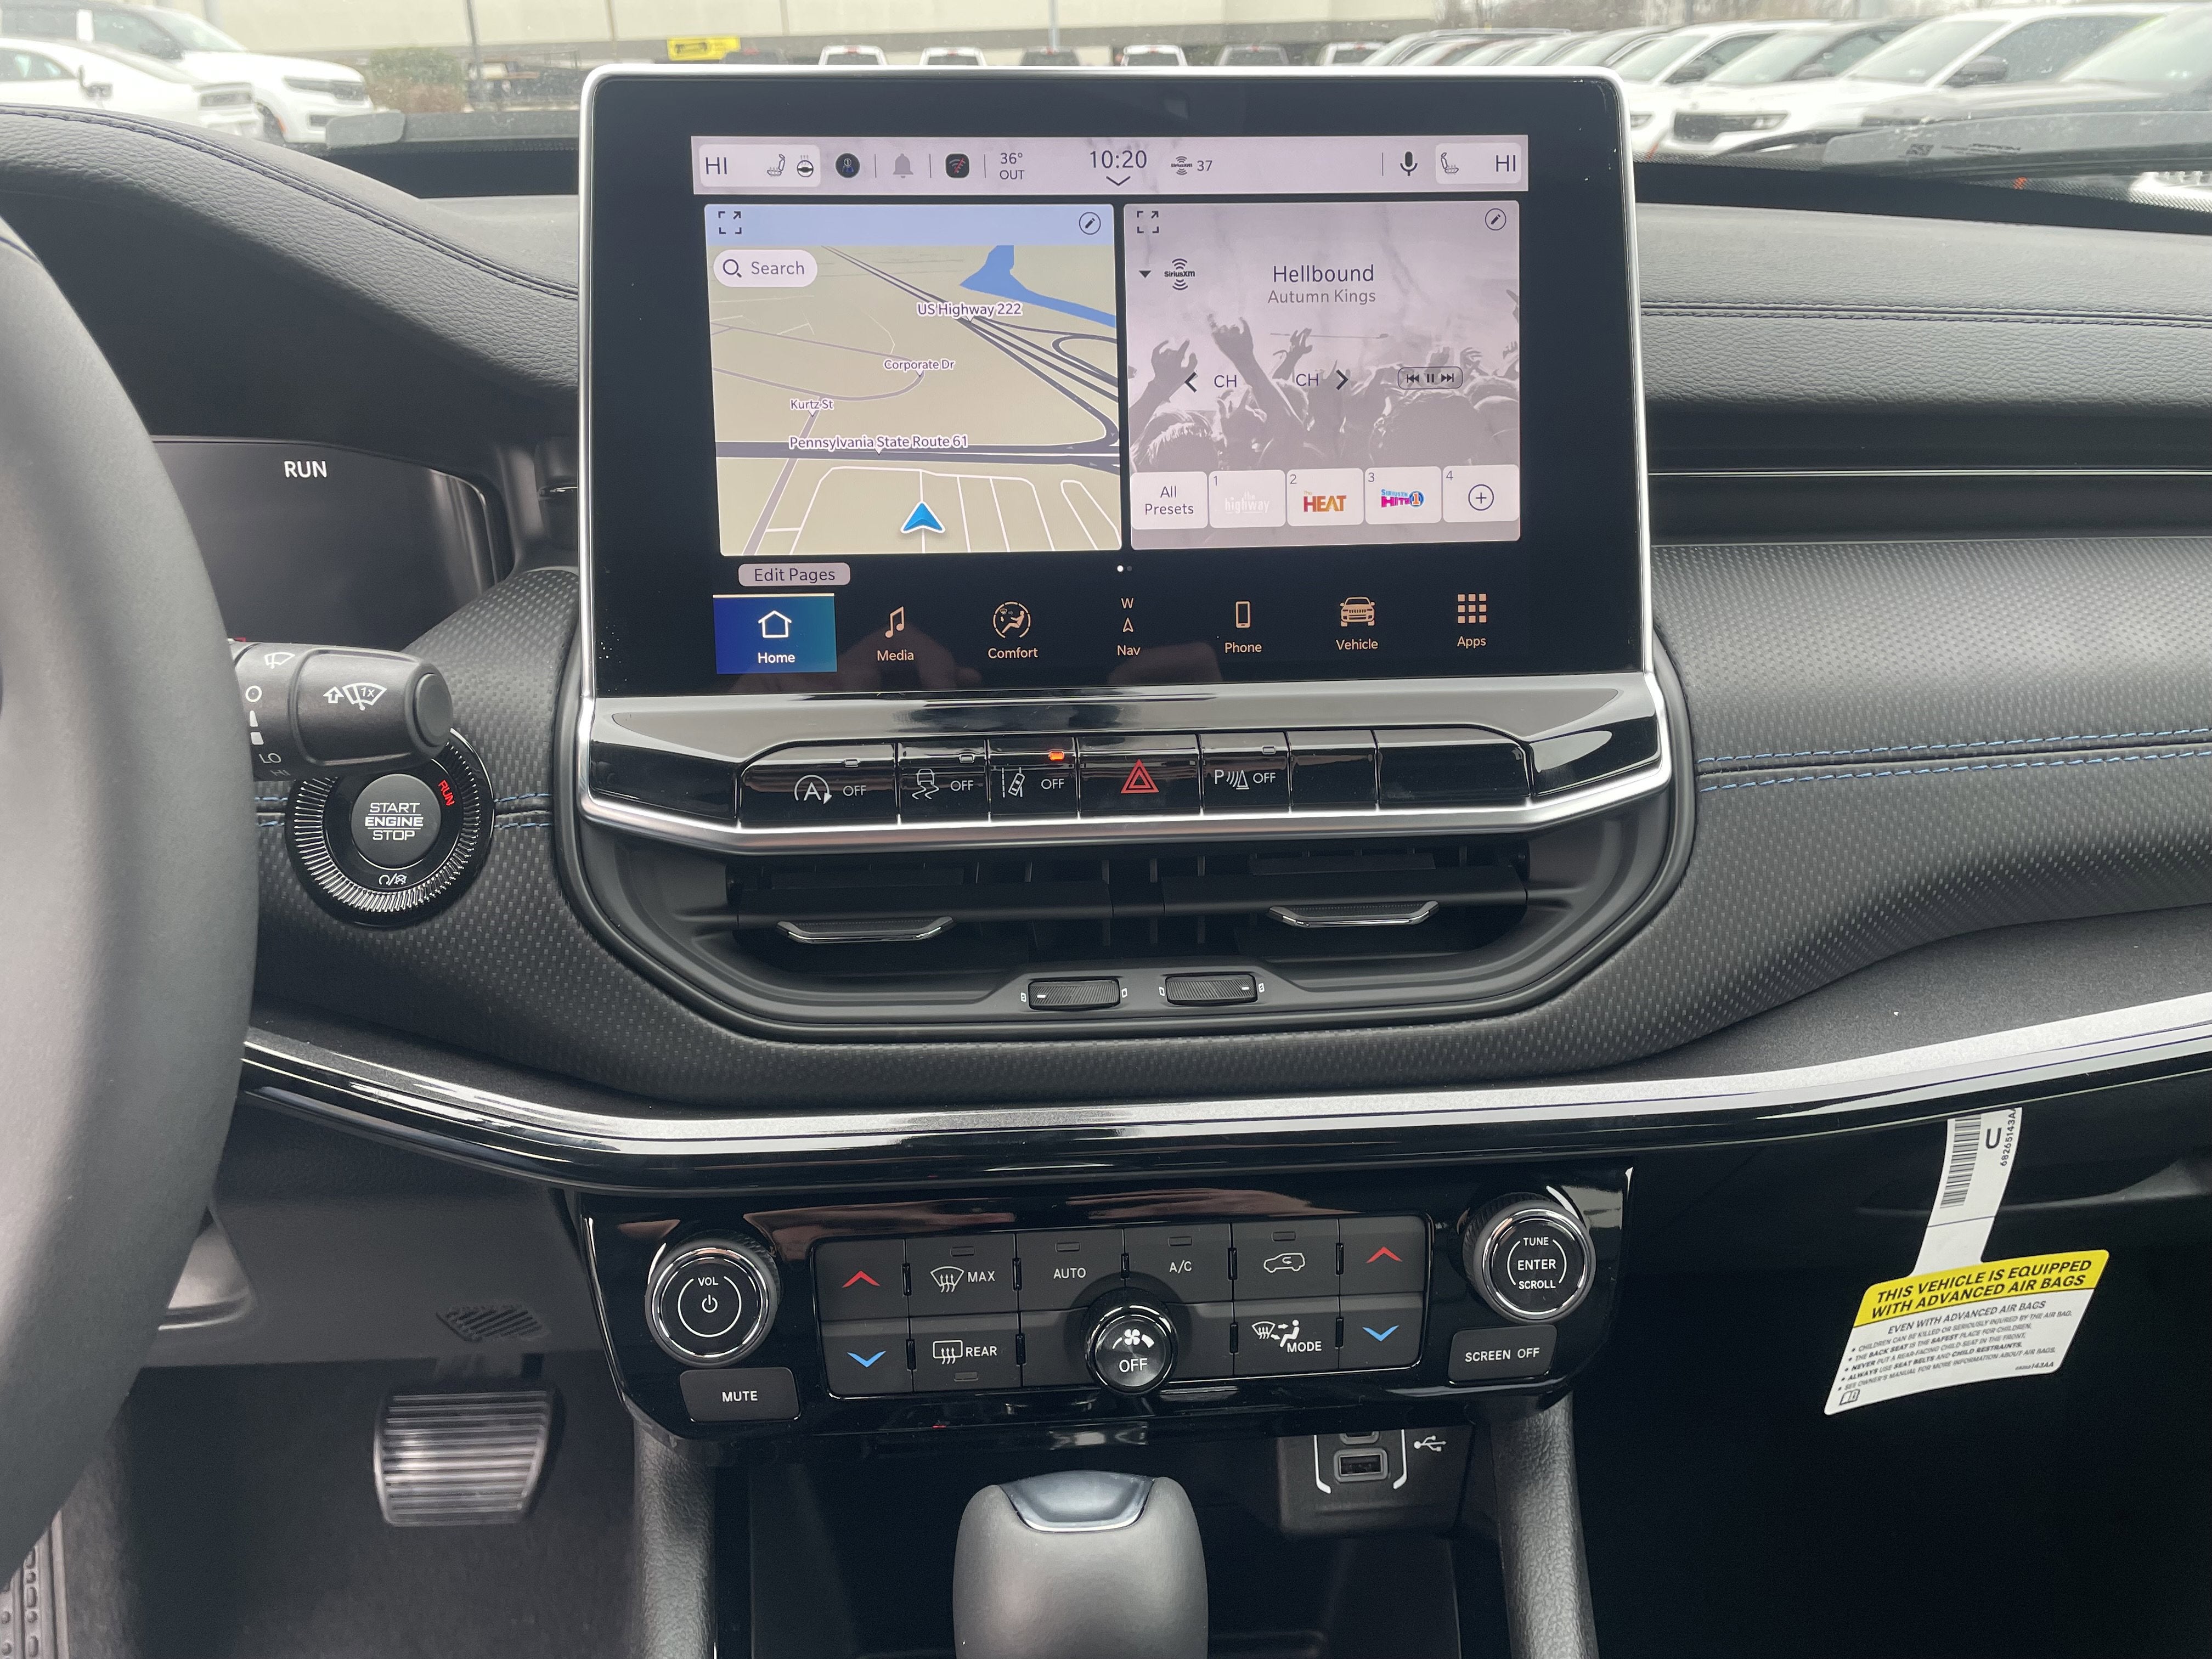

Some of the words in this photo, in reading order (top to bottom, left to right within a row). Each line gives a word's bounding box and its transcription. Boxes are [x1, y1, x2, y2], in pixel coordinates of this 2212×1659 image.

[1000, 153, 1023, 165] 36°
[1090, 150, 1147, 169] 10:20
[1496, 155, 1516, 172] HI
[705, 157, 727, 175] HI
[1197, 160, 1212, 171] 37
[1000, 170, 1025, 180] OUT
[751, 261, 805, 275] Search
[1273, 264, 1374, 283] Hellbound
[1268, 290, 1329, 304] Autumn
[1334, 289, 1376, 306] Kings
[918, 303, 935, 315] US
[938, 303, 995, 318] Highway
[997, 303, 1022, 315] 222
[884, 359, 939, 372] Corporate
[941, 359, 955, 370] Dr
[1214, 374, 1238, 387] CH
[1295, 373, 1319, 386] CH
[791, 399, 820, 410] Kurtz
[821, 399, 833, 410] St
[788, 436, 874, 451] Pennsylvania
[877, 436, 910, 448] State
[912, 436, 949, 448] Route
[952, 435, 968, 448] 61
[284, 461, 328, 478] RUN
[1213, 476, 1218, 486] 1
[1290, 474, 1297, 484] 2
[1368, 472, 1375, 483] 3
[1446, 470, 1453, 482] 4
[1160, 486, 1177, 498] All
[1145, 503, 1194, 516] Presets
[1224, 497, 1269, 514] highway
[1303, 495, 1347, 513] HEAT
[754, 568, 786, 582] Edit
[789, 568, 836, 584] Pages
[1121, 598, 1134, 608] W
[1224, 642, 1262, 653] Phone
[1336, 639, 1379, 651] Vehicle
[1457, 636, 1487, 650] Apps
[877, 650, 915, 662] Media
[988, 647, 1039, 659] Comfort
[1117, 645, 1141, 656] Nav
[758, 652, 795, 664] Home
[259, 753, 281, 764] LO
[1041, 778, 1065, 789] OFF
[1252, 772, 1276, 783] OFF
[843, 785, 867, 797] OFF
[950, 780, 974, 792] OFF
[438, 780, 455, 807] RUN
[370, 803, 420, 814] START
[365, 816, 424, 827] ENGINE
[373, 830, 415, 840] STOP
[1986, 1127, 2002, 1149] U
[1523, 1237, 1550, 1246] TUNE
[1169, 1260, 1192, 1273] A/C
[1517, 1259, 1556, 1271] ENTER
[967, 1271, 995, 1283] MAX
[1053, 1267, 1087, 1279] AUTO
[698, 1277, 719, 1286] VOL
[1519, 1279, 1556, 1289] SCROLL
[1877, 1285, 1914, 1304] THIS
[1918, 1272, 1987, 1294] VEHICLE
[1988, 1269, 2005, 1282] IS
[2007, 1260, 2092, 1279] EQUIPPED
[1871, 1299, 1913, 1319] WITH
[1915, 1284, 2005, 1309] ADVANCED
[2007, 1279, 2037, 1293] AIR
[2040, 1274, 2086, 1289] BAGS
[1888, 1322, 1915, 1334] EVEN
[1917, 1316, 1942, 1328] WITH
[1943, 1307, 1997, 1323] ADVANCED
[2000, 1304, 2017, 1313] AIR
[2018, 1301, 2046, 1310] BAGS
[1858, 1339, 1892, 1352] CHILDREN
[1892, 1335, 1907, 1344] CAN
[1918, 1328, 1940, 1338] KILLED
[1953, 1319, 1989, 1331] SERIOUSLY
[1990, 1316, 2018, 1325] INJURED
[1286, 1340, 1322, 1353] MODE
[1855, 1353, 1867, 1361] THE
[1869, 1348, 1889, 1358] BACK
[1890, 1344, 1908, 1353] SEAT
[1917, 1339, 1930, 1347] THE
[1931, 1334, 1959, 1344] SAFEST
[1959, 1329, 1981, 1339] PLACE
[1996, 1323, 2032, 1333] CHILDREN.
[966, 1346, 997, 1357] REAR
[1465, 1349, 1512, 1363] SCREEN
[1516, 1346, 1540, 1359] OFF
[1119, 1358, 1148, 1374] OFF
[1847, 1368, 1878, 1381] ALWAYS
[1879, 1364, 1892, 1373] USE
[1893, 1360, 1911, 1369] SEAT
[1913, 1355, 1935, 1365] BELTS
[1936, 1352, 1951, 1360] AND
[1951, 1348, 1975, 1357] CHILD
[1976, 1342, 2022, 1352] RESTRAINTS.
[721, 1391, 758, 1402] MUTE
